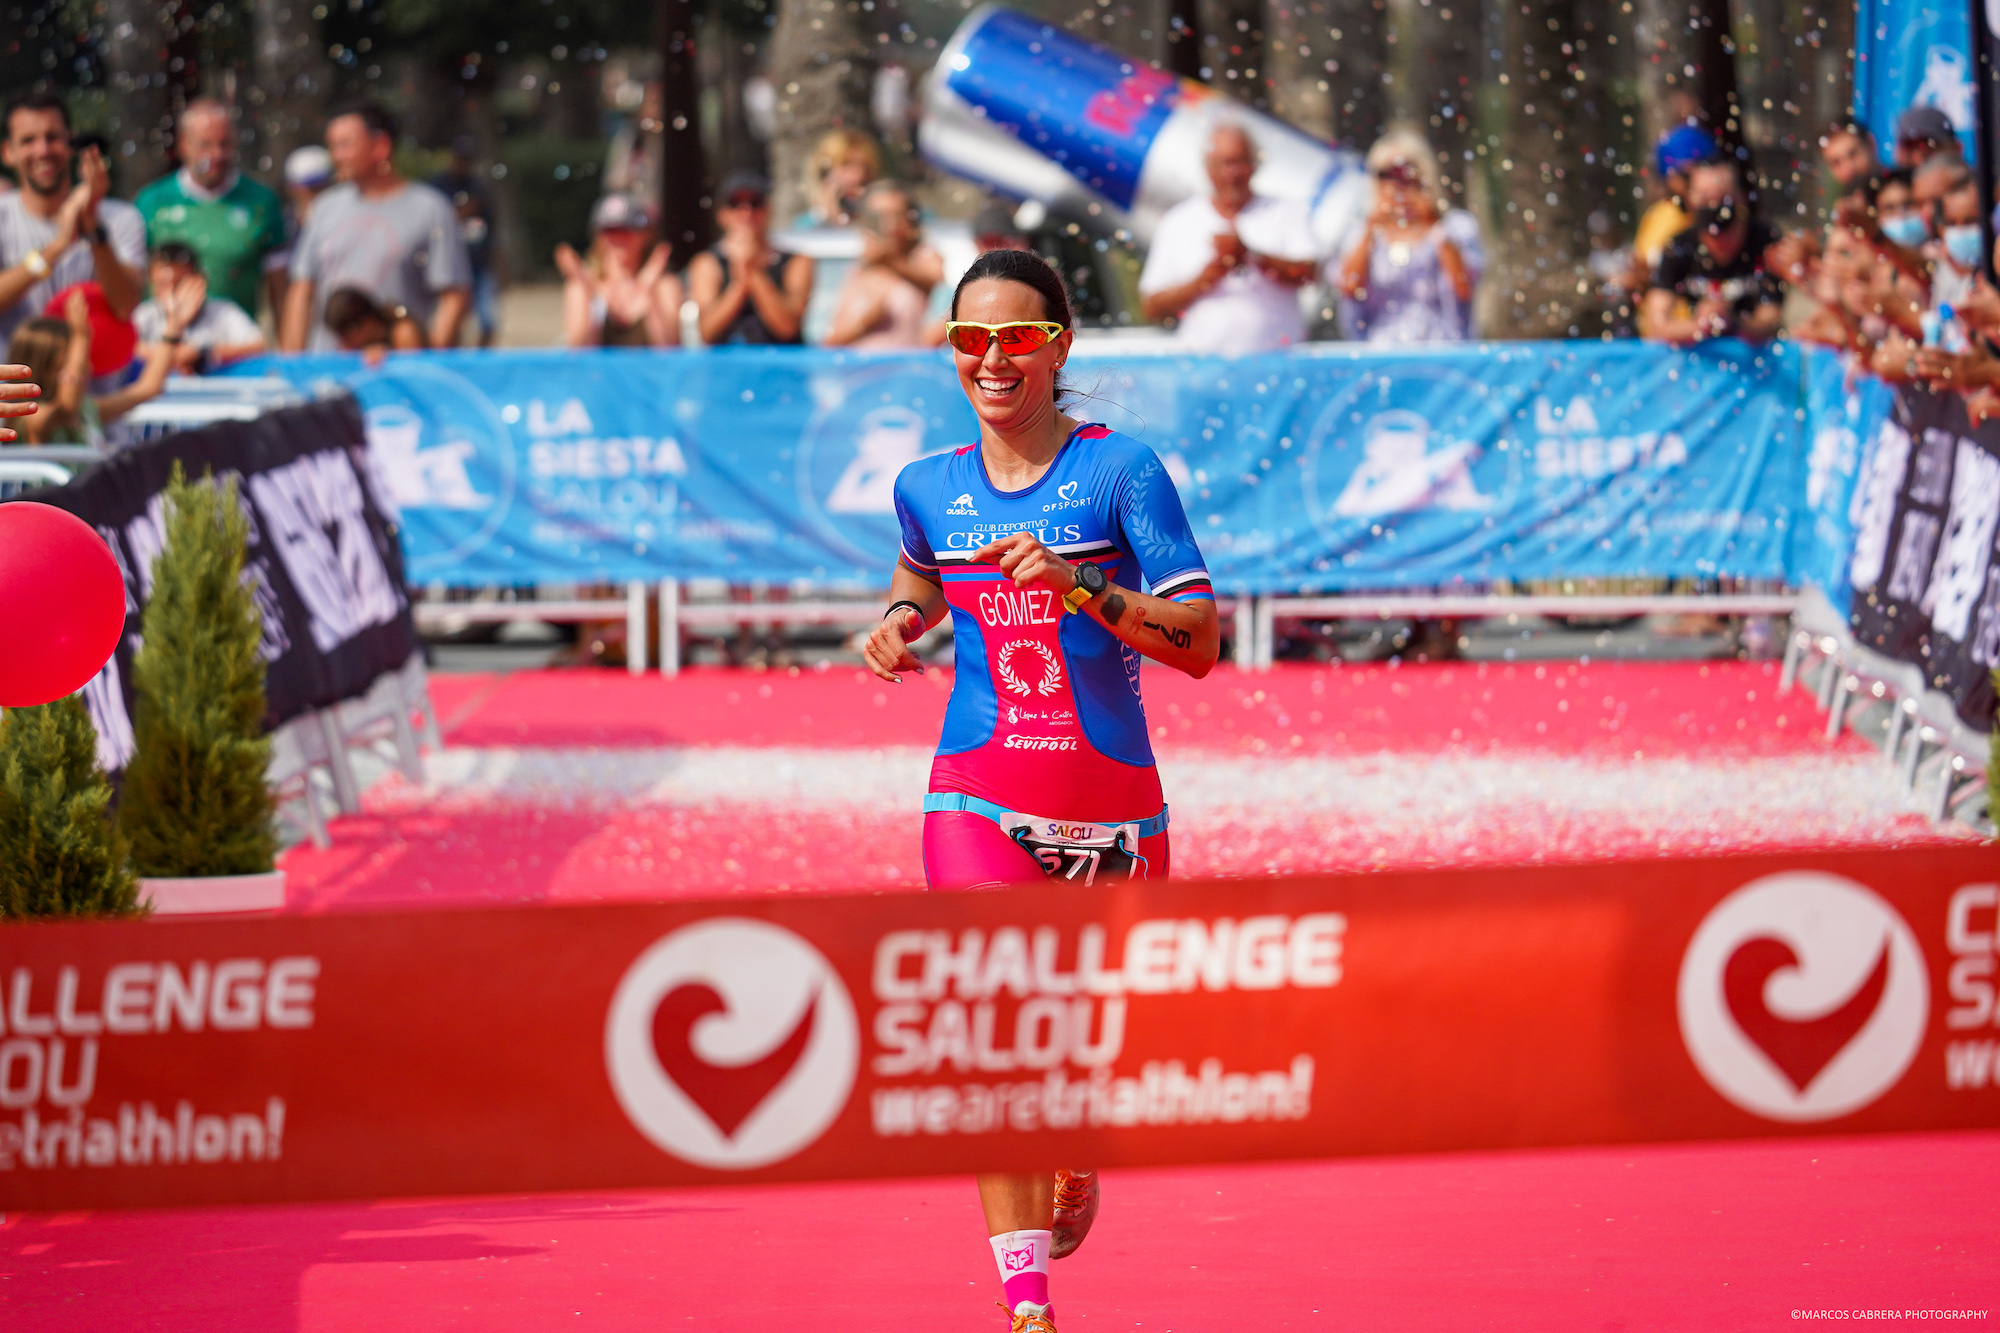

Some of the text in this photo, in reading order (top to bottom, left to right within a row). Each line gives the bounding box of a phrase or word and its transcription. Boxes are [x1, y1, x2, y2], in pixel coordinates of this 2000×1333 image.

[527, 397, 593, 436] LA
[1042, 497, 1091, 513] OFSPORT
[946, 524, 1081, 548] CREUS
[973, 519, 1049, 532] CLUB DEPORTIVO
[979, 584, 1056, 627] GÓMEZ
[1003, 734, 1078, 751] SEVIPOOL
[1047, 823, 1093, 840] SALOU
[872, 912, 1346, 1001] CHALLENGE
[0, 956, 320, 1035] LLENGE
[872, 997, 1128, 1075] SALOU
